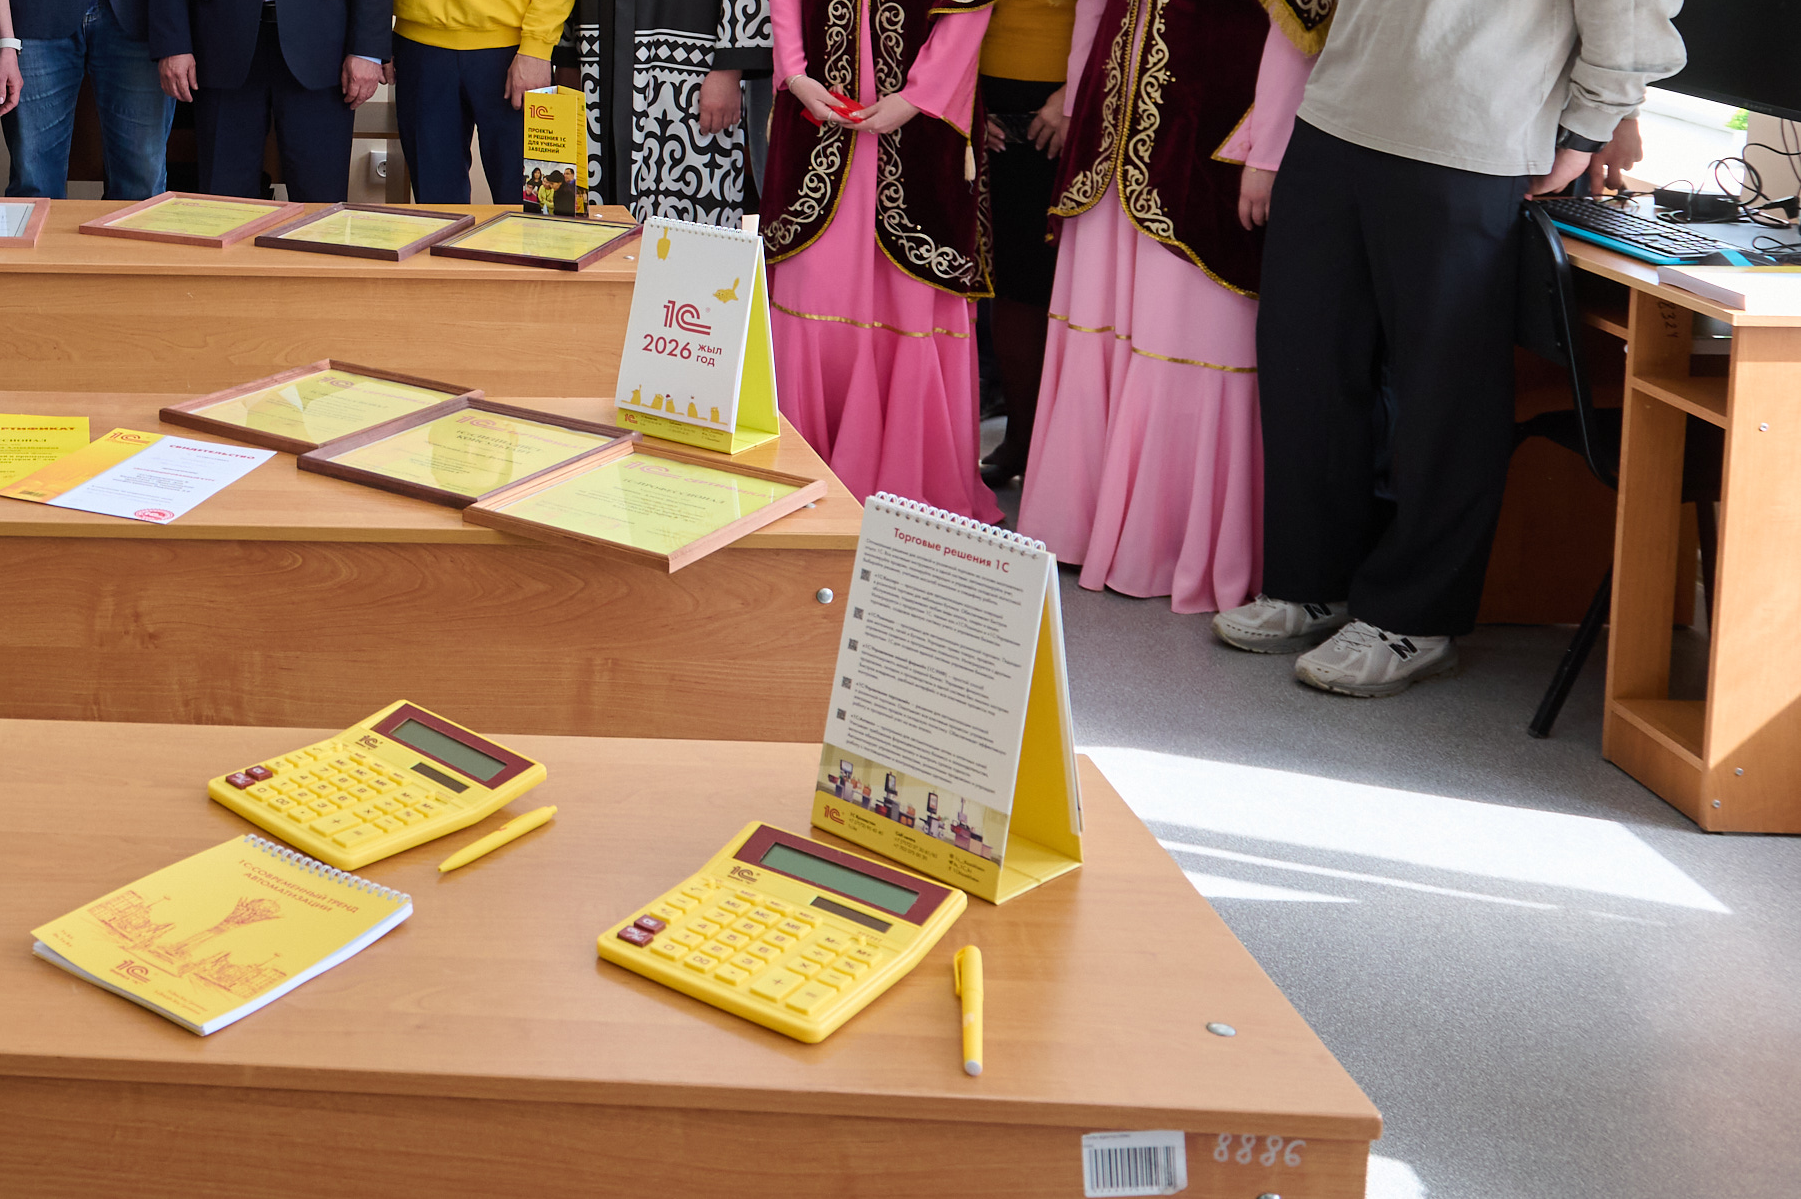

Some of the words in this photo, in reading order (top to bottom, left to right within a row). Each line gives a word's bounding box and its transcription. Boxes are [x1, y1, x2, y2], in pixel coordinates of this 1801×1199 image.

[529, 104, 554, 120] 1С
[663, 300, 712, 336] 1С
[642, 333, 692, 360] 2026
[894, 527, 941, 551] Торговые
[944, 545, 992, 568] решения
[995, 560, 1010, 573] 1С
[730, 866, 758, 883] 1С
[1213, 1133, 1307, 1167] 8886
